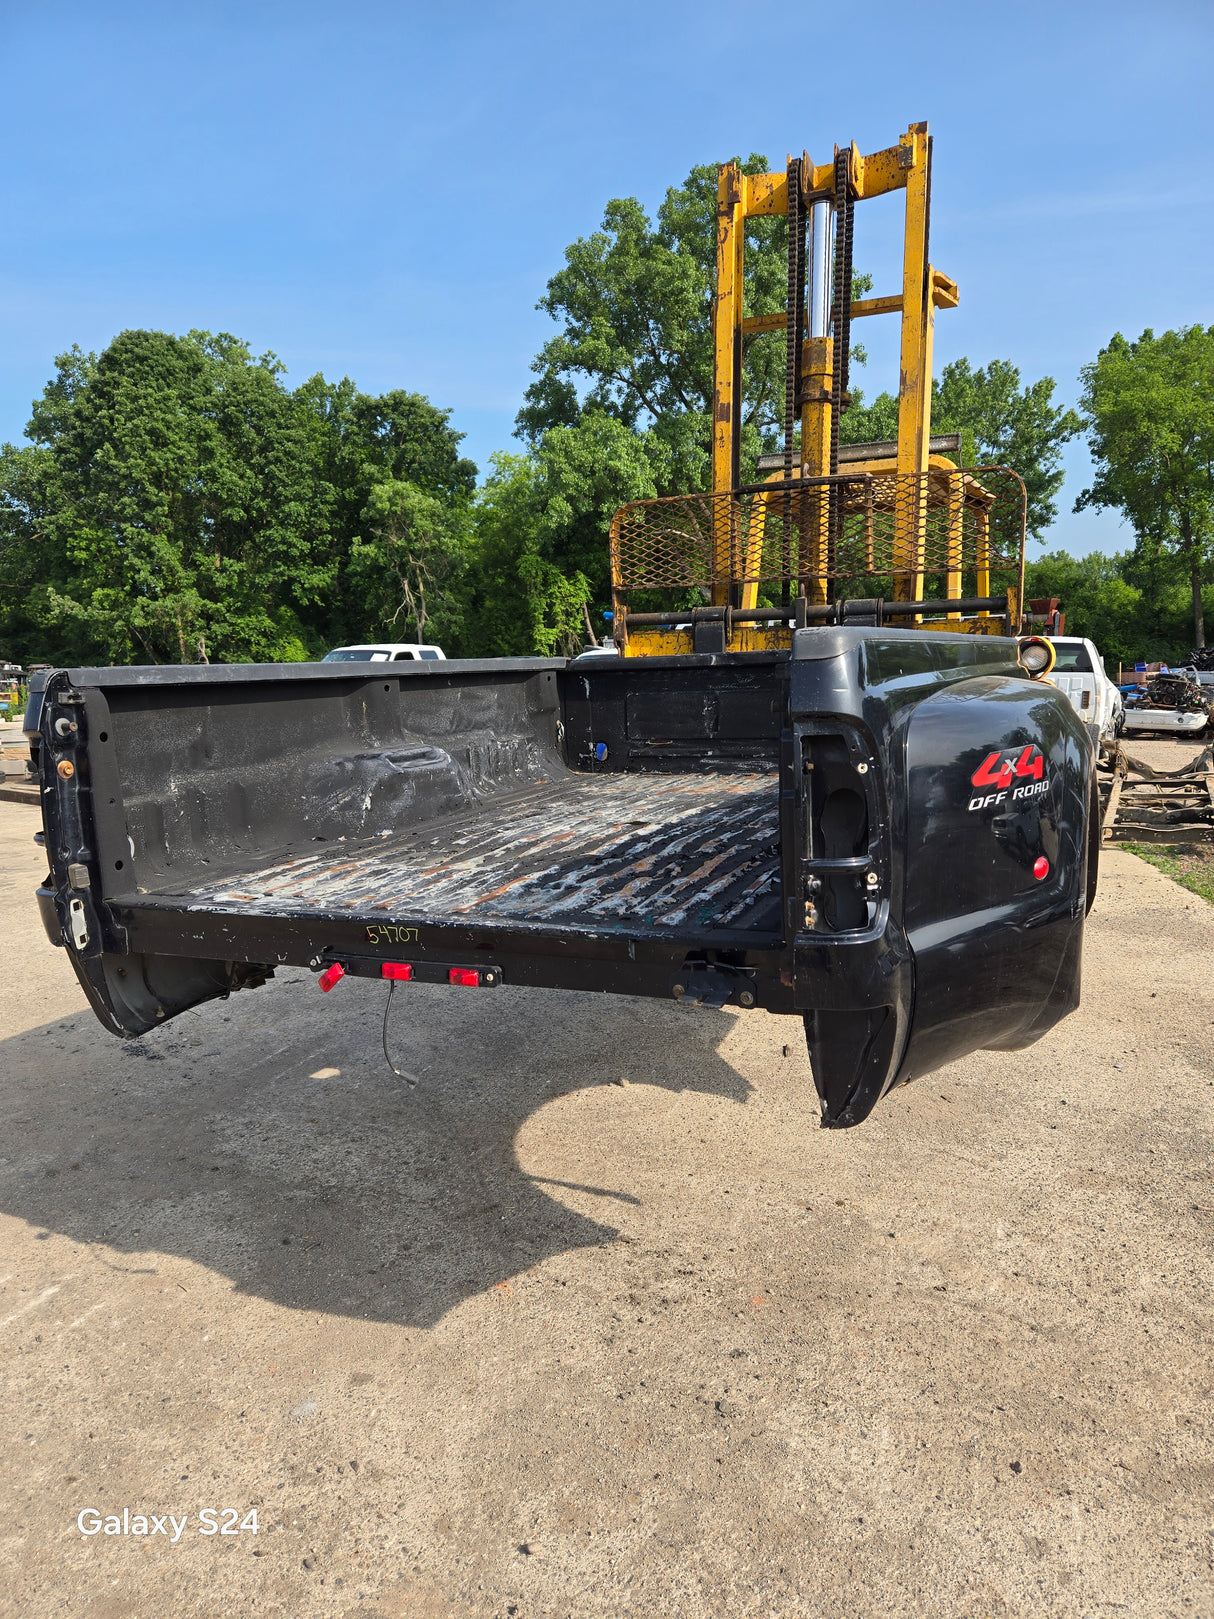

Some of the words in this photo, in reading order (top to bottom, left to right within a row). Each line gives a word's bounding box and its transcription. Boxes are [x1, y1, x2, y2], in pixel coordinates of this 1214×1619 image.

[968, 791, 1008, 811] OFF
[1012, 780, 1050, 801] ROAD
[365, 925, 419, 944] 54707
